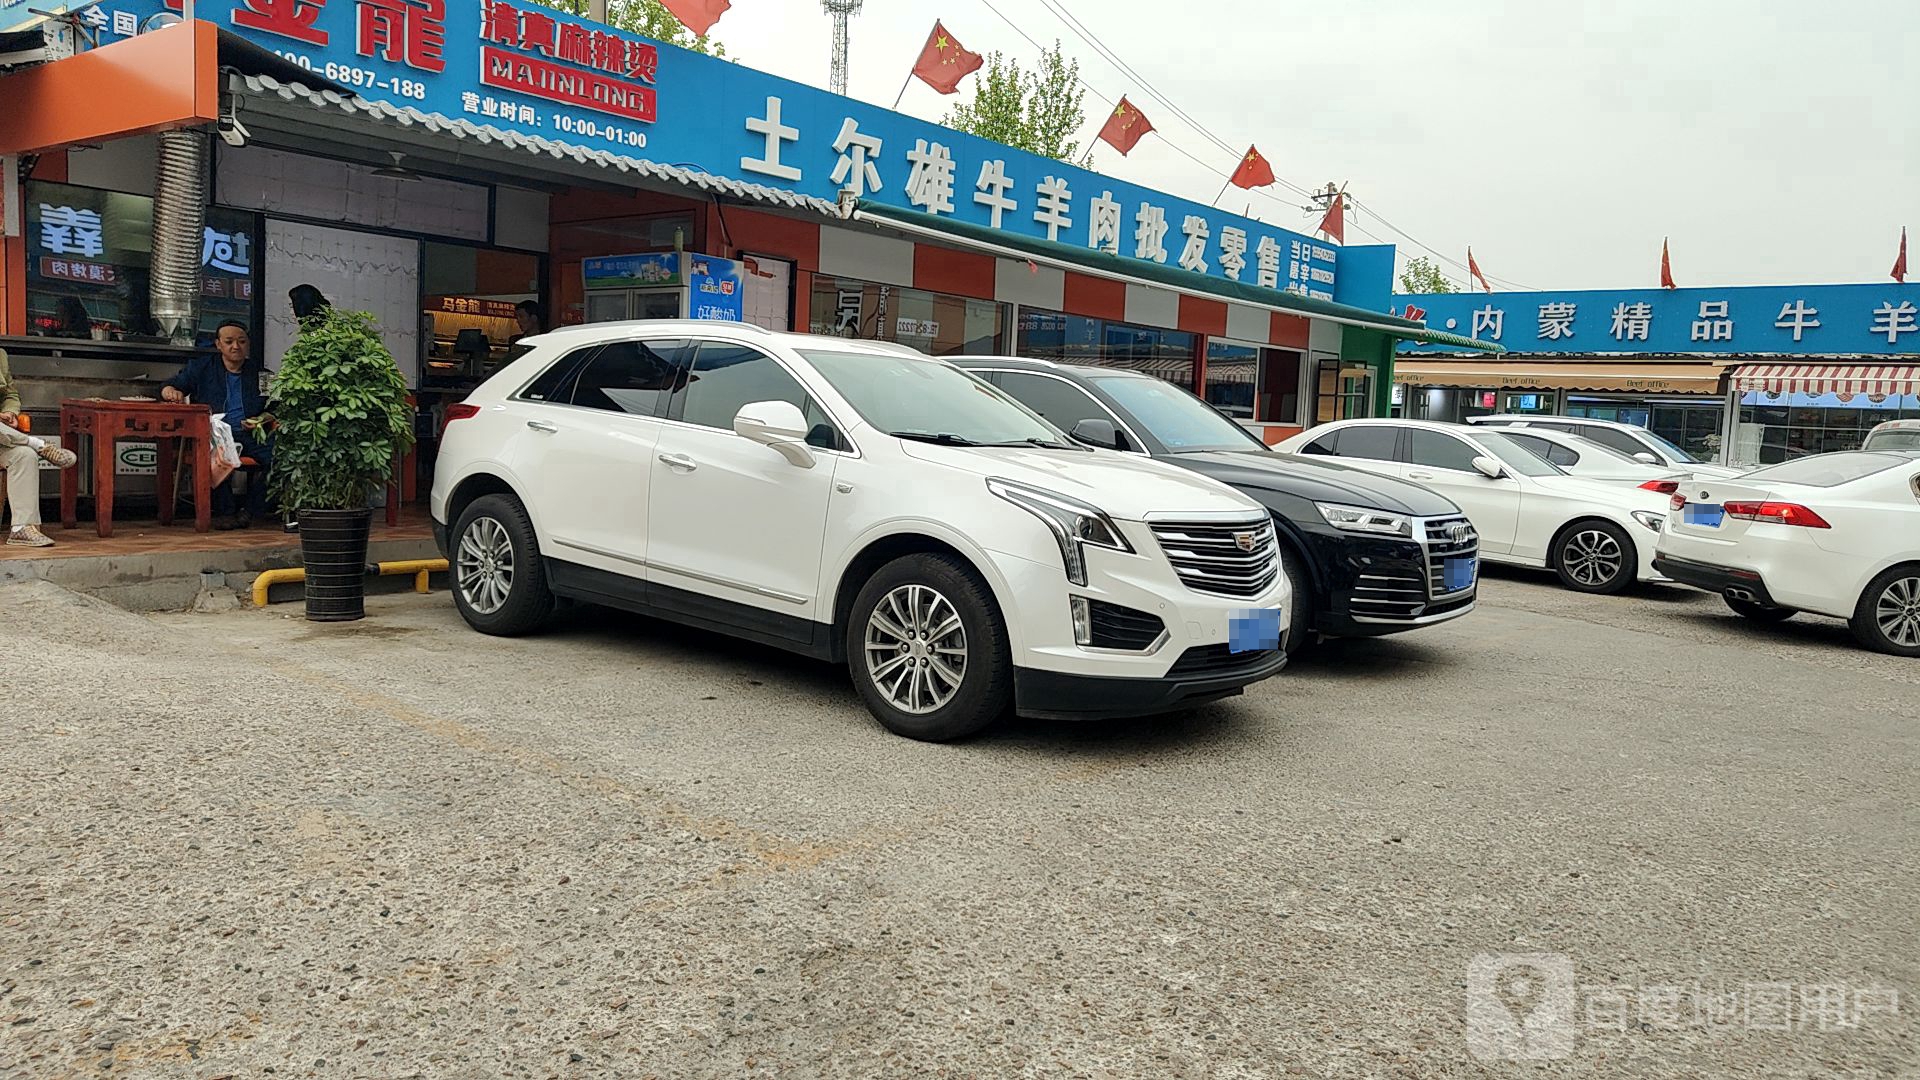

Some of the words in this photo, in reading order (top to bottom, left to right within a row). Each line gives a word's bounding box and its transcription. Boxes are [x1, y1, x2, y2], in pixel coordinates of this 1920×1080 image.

[273, 50, 426, 101] 00-6897-188
[741, 96, 1281, 288] 土尔雄牛羊肉批发零售
